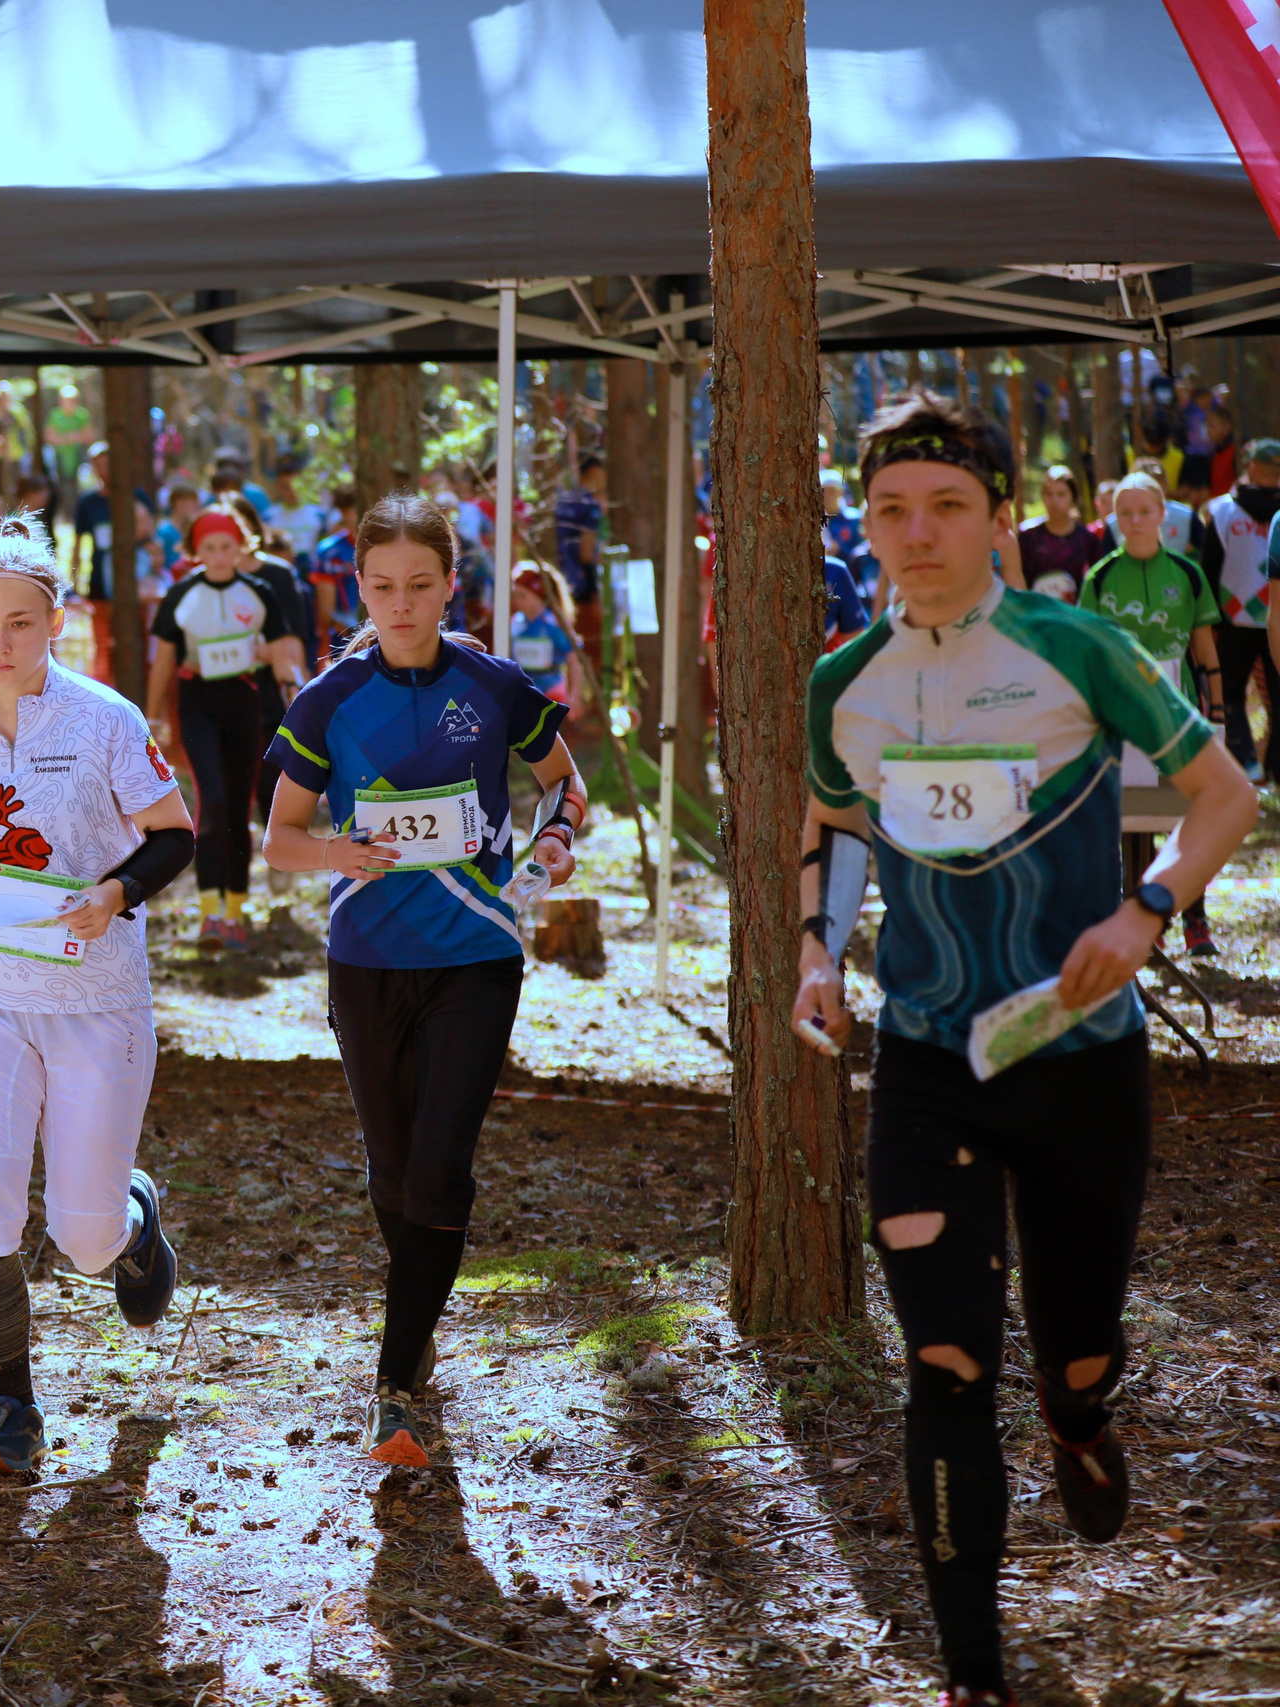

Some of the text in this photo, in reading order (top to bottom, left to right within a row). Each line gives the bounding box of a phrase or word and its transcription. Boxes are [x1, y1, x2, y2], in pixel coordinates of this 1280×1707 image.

[450, 735, 477, 743] ТРОПА
[458, 798, 469, 839] ПЕРМСКИЙ
[925, 782, 974, 821] 28
[382, 814, 439, 841] 432
[468, 805, 476, 838] ПЕРИОД
[933, 1459, 949, 1534] NORD
